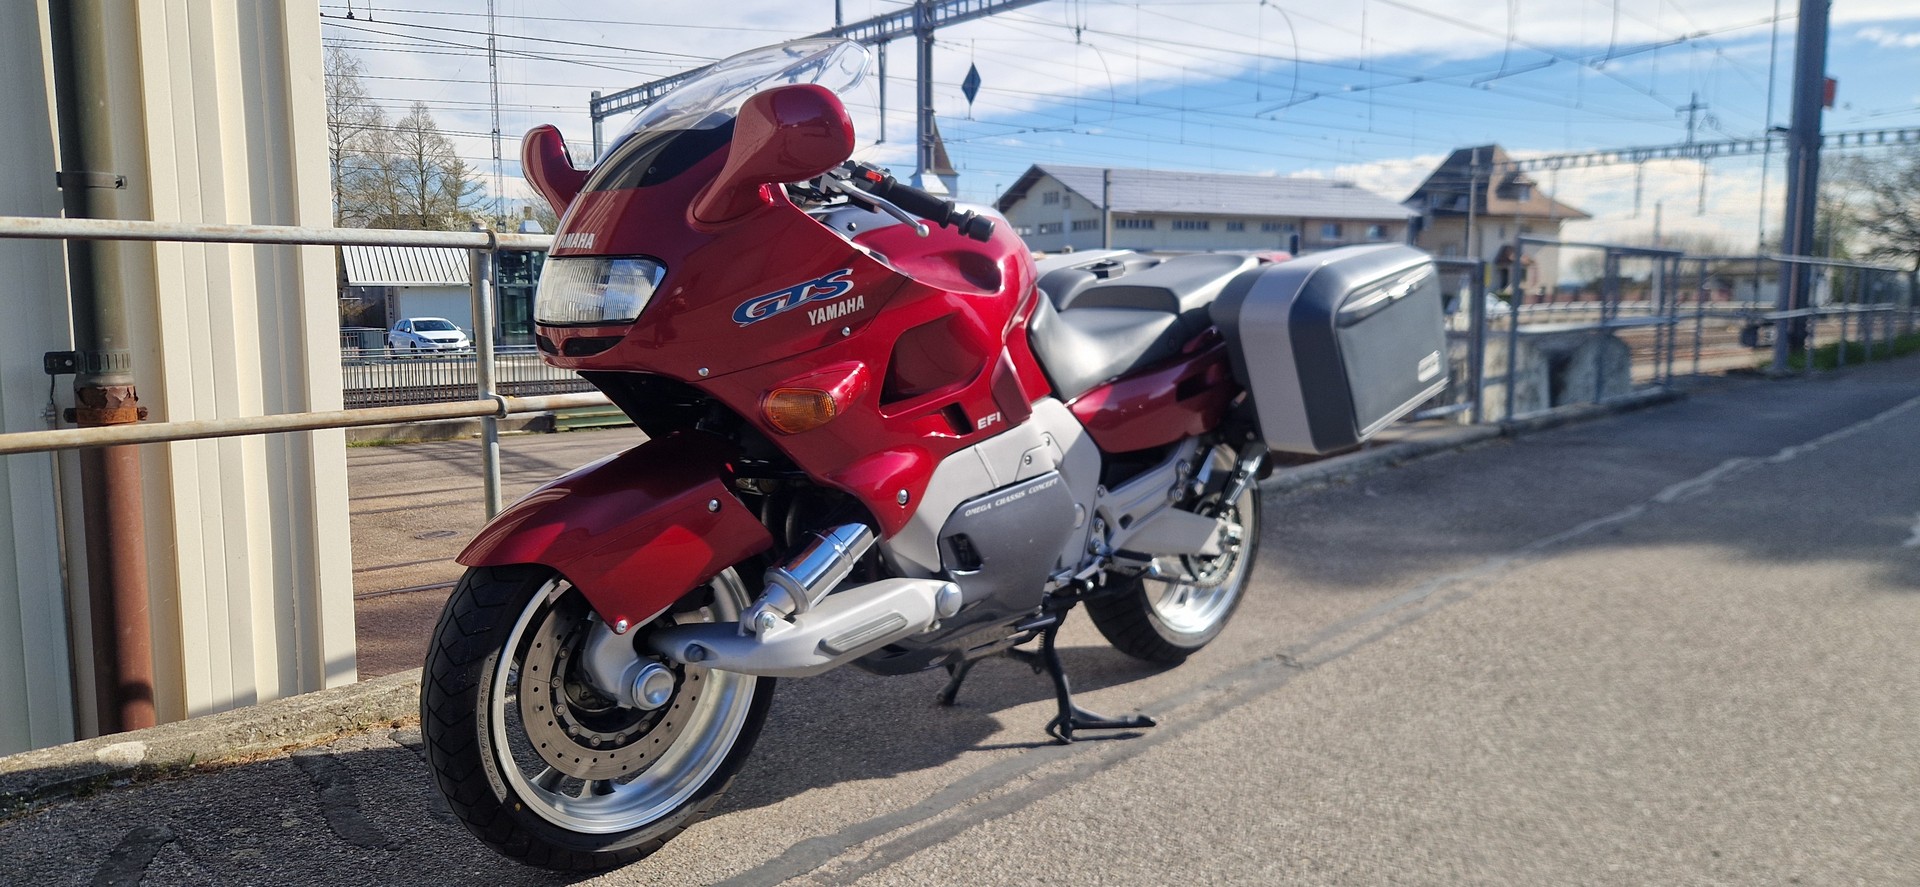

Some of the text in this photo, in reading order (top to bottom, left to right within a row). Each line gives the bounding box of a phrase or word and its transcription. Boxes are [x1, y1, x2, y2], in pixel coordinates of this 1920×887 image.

[558, 232, 595, 249] AMAHA
[732, 268, 854, 327] GTS
[808, 295, 865, 326] YAMAHA
[977, 411, 1001, 430] EFI
[964, 477, 1059, 517] OMEGA CHASSIS CONCEPT
